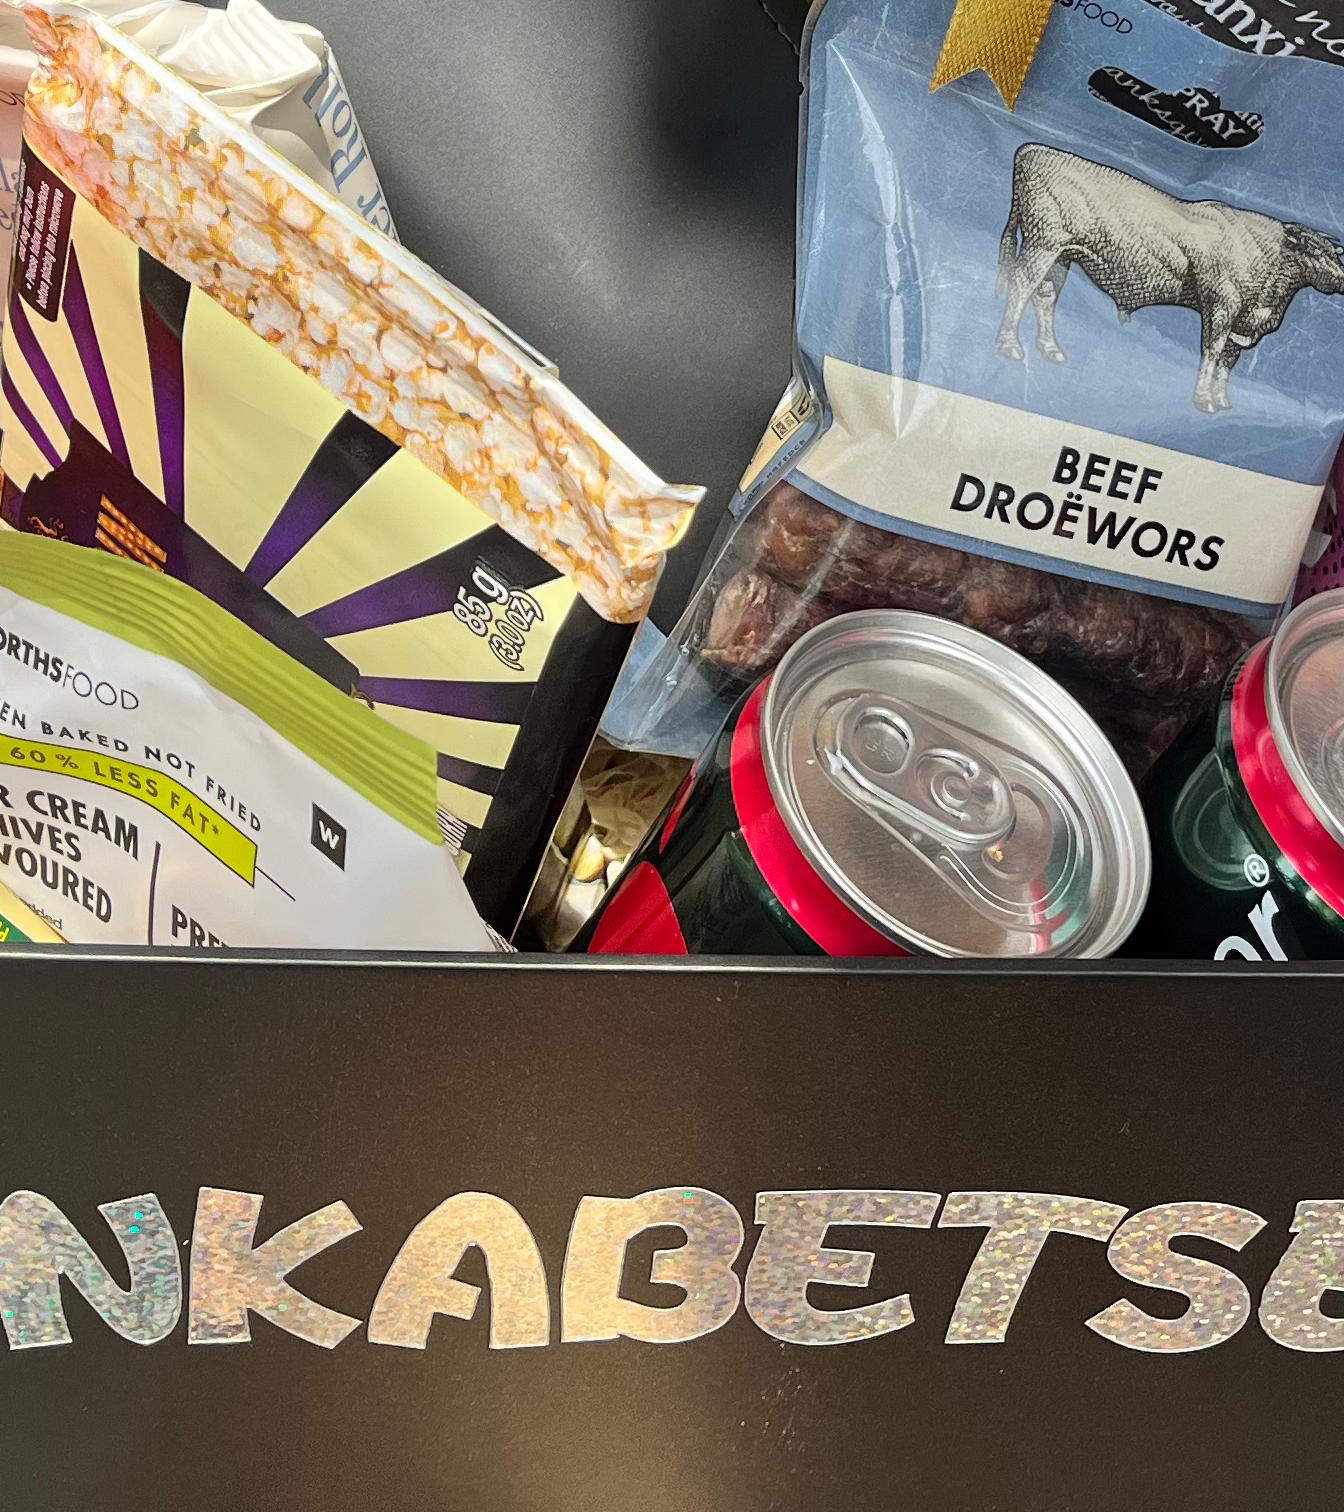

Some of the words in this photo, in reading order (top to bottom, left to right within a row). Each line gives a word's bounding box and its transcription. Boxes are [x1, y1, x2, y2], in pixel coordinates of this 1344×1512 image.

[1052, 445, 1164, 506] BEEF
[948, 472, 1225, 574] DROËWORS
[452, 585, 494, 638] 85
[9, 745, 48, 766] 60
[55, 752, 81, 771] %
[93, 759, 159, 799] LESS
[41, 719, 130, 754] BAKED
[144, 743, 196, 779] NOT
[204, 775, 263, 833] FRIED
[25, 789, 140, 862] CREAM
